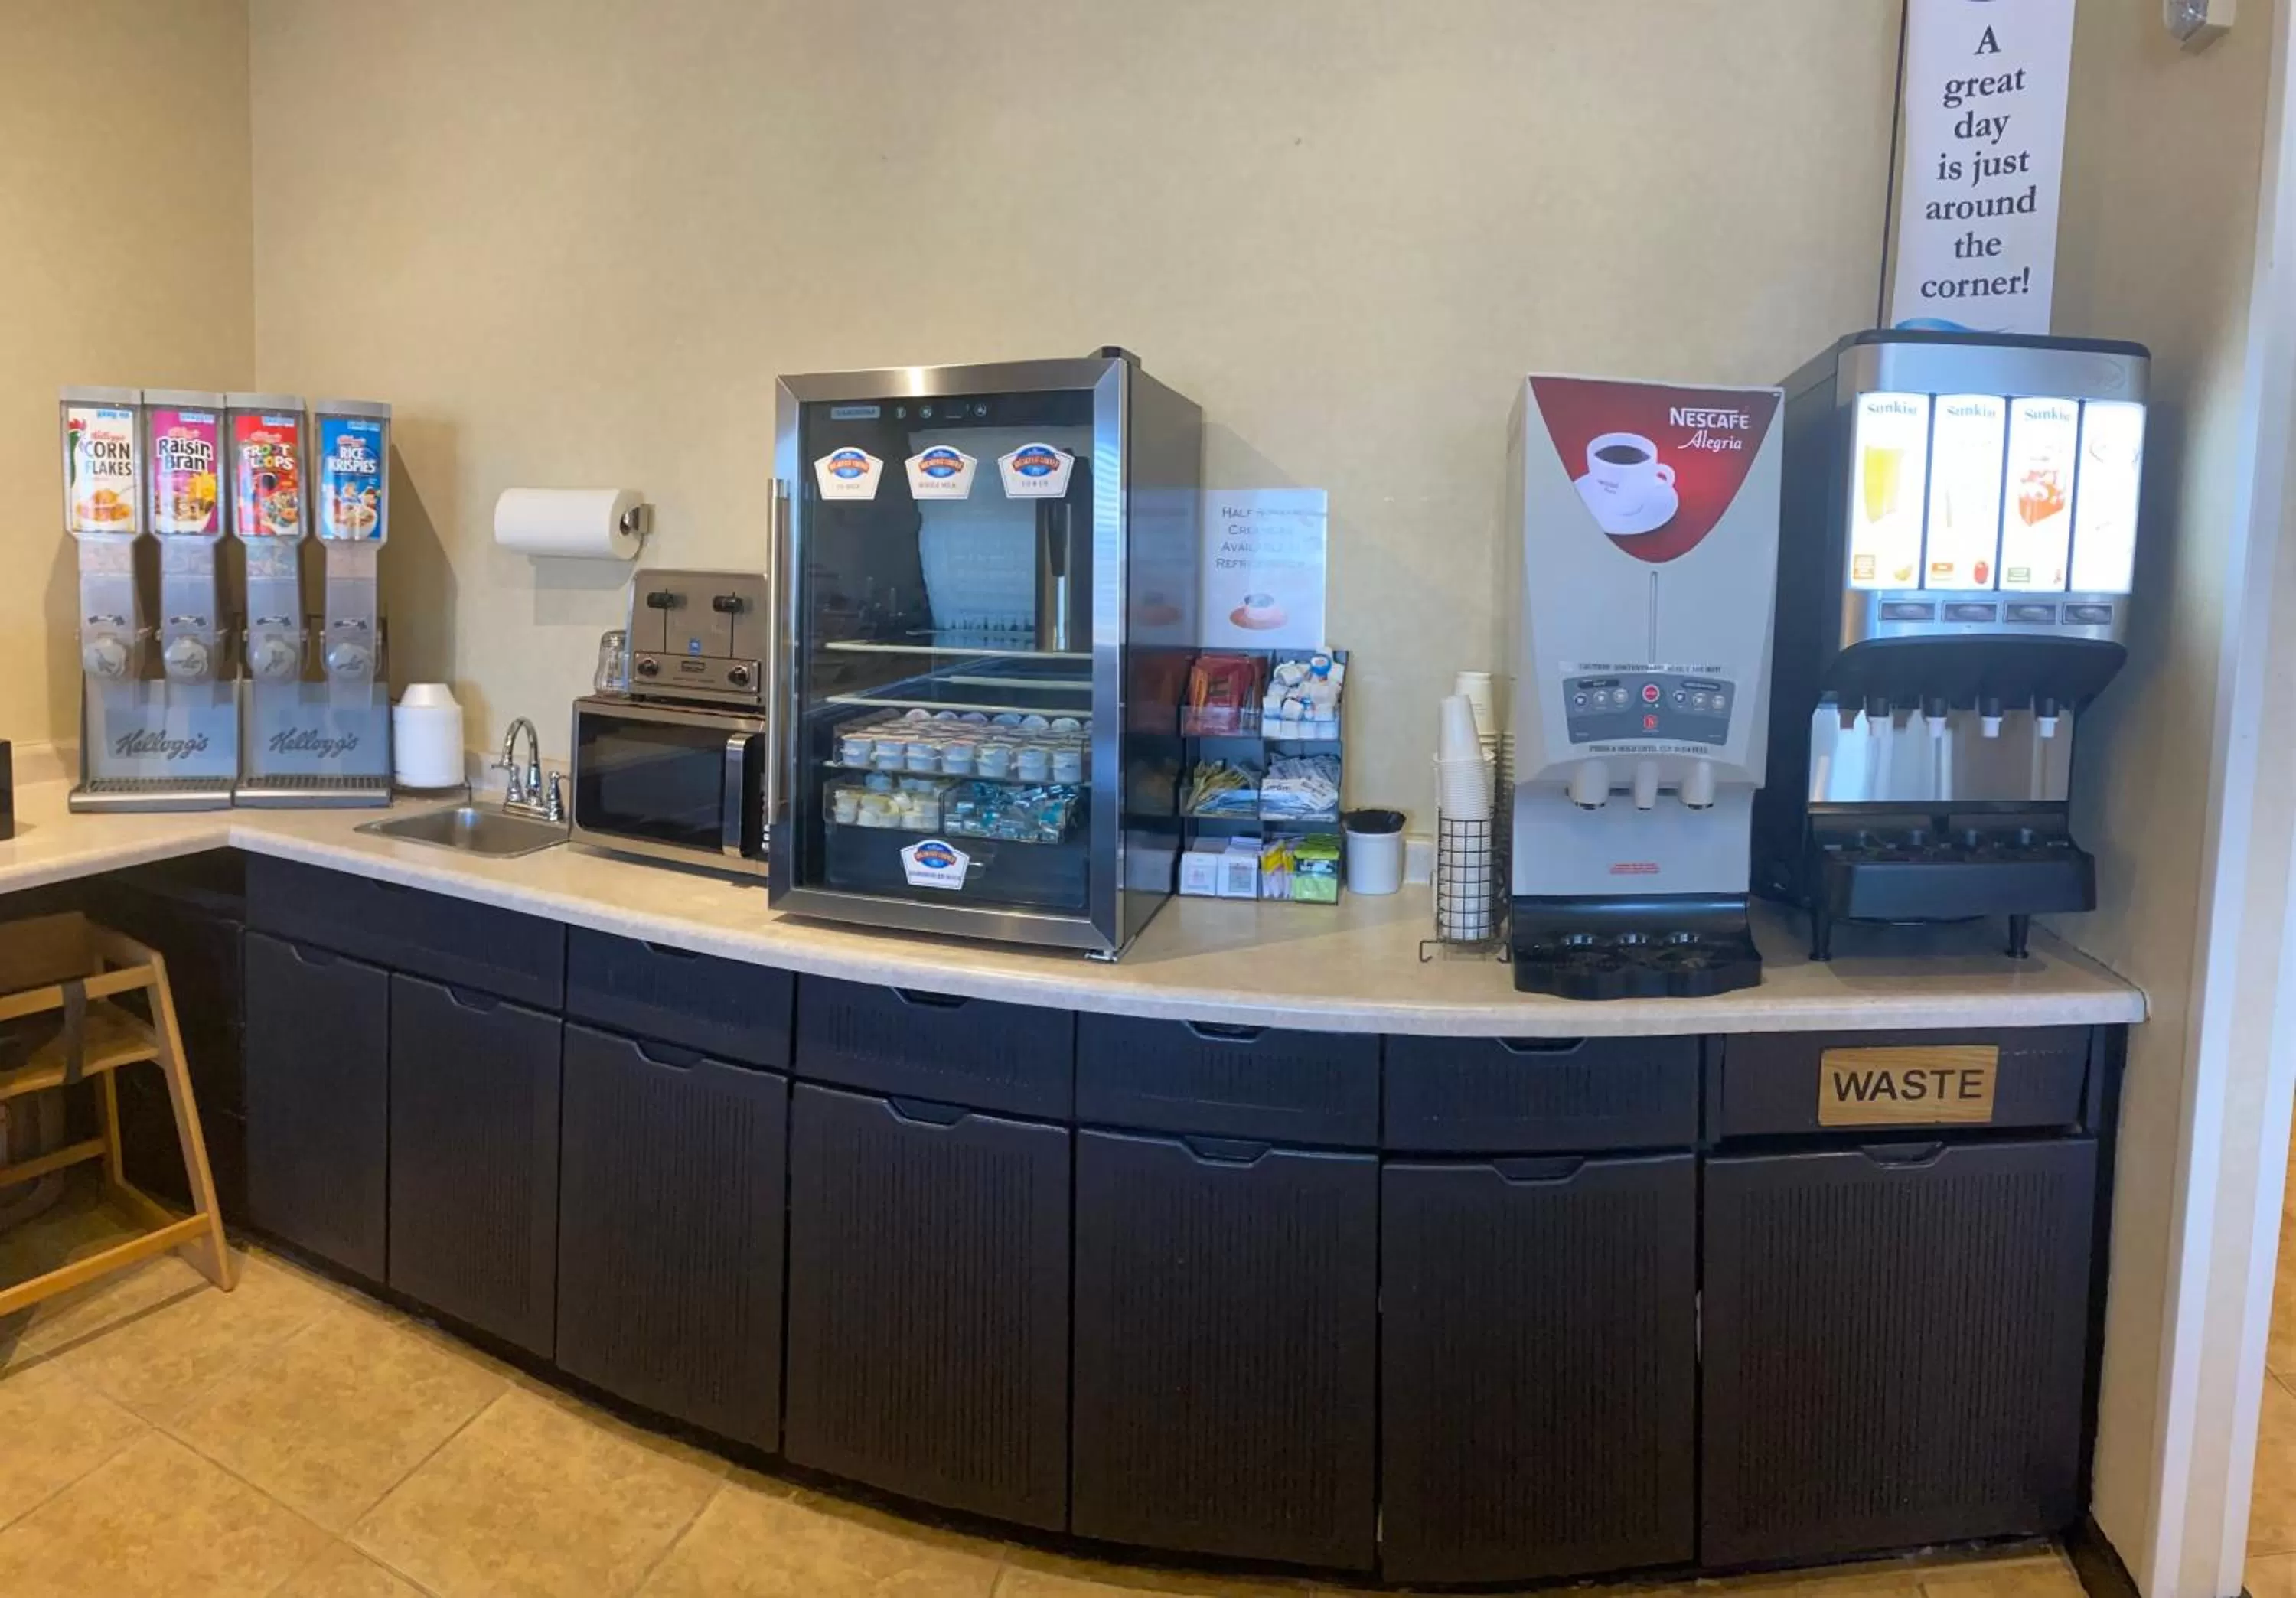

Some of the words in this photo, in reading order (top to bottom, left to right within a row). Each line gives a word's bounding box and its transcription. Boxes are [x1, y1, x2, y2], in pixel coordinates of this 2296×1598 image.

[1974, 25, 2001, 54] A
[1944, 68, 2026, 108] great
[1954, 112, 2011, 144] day
[1936, 153, 1962, 181] is
[1971, 150, 2030, 186] just
[1926, 185, 2037, 220] around
[1954, 232, 2002, 258] the
[1920, 267, 2030, 298] corner!
[84, 441, 130, 459] CORN
[158, 438, 212, 458] Raisin
[1677, 429, 1743, 452] Alegria
[85, 461, 132, 476] FLAKES
[165, 455, 206, 470] Bran
[250, 455, 295, 471] LOOPS
[116, 727, 210, 760] Kellogg's
[269, 726, 360, 758] Kellogg's
[1833, 1069, 1985, 1101] WASTE
